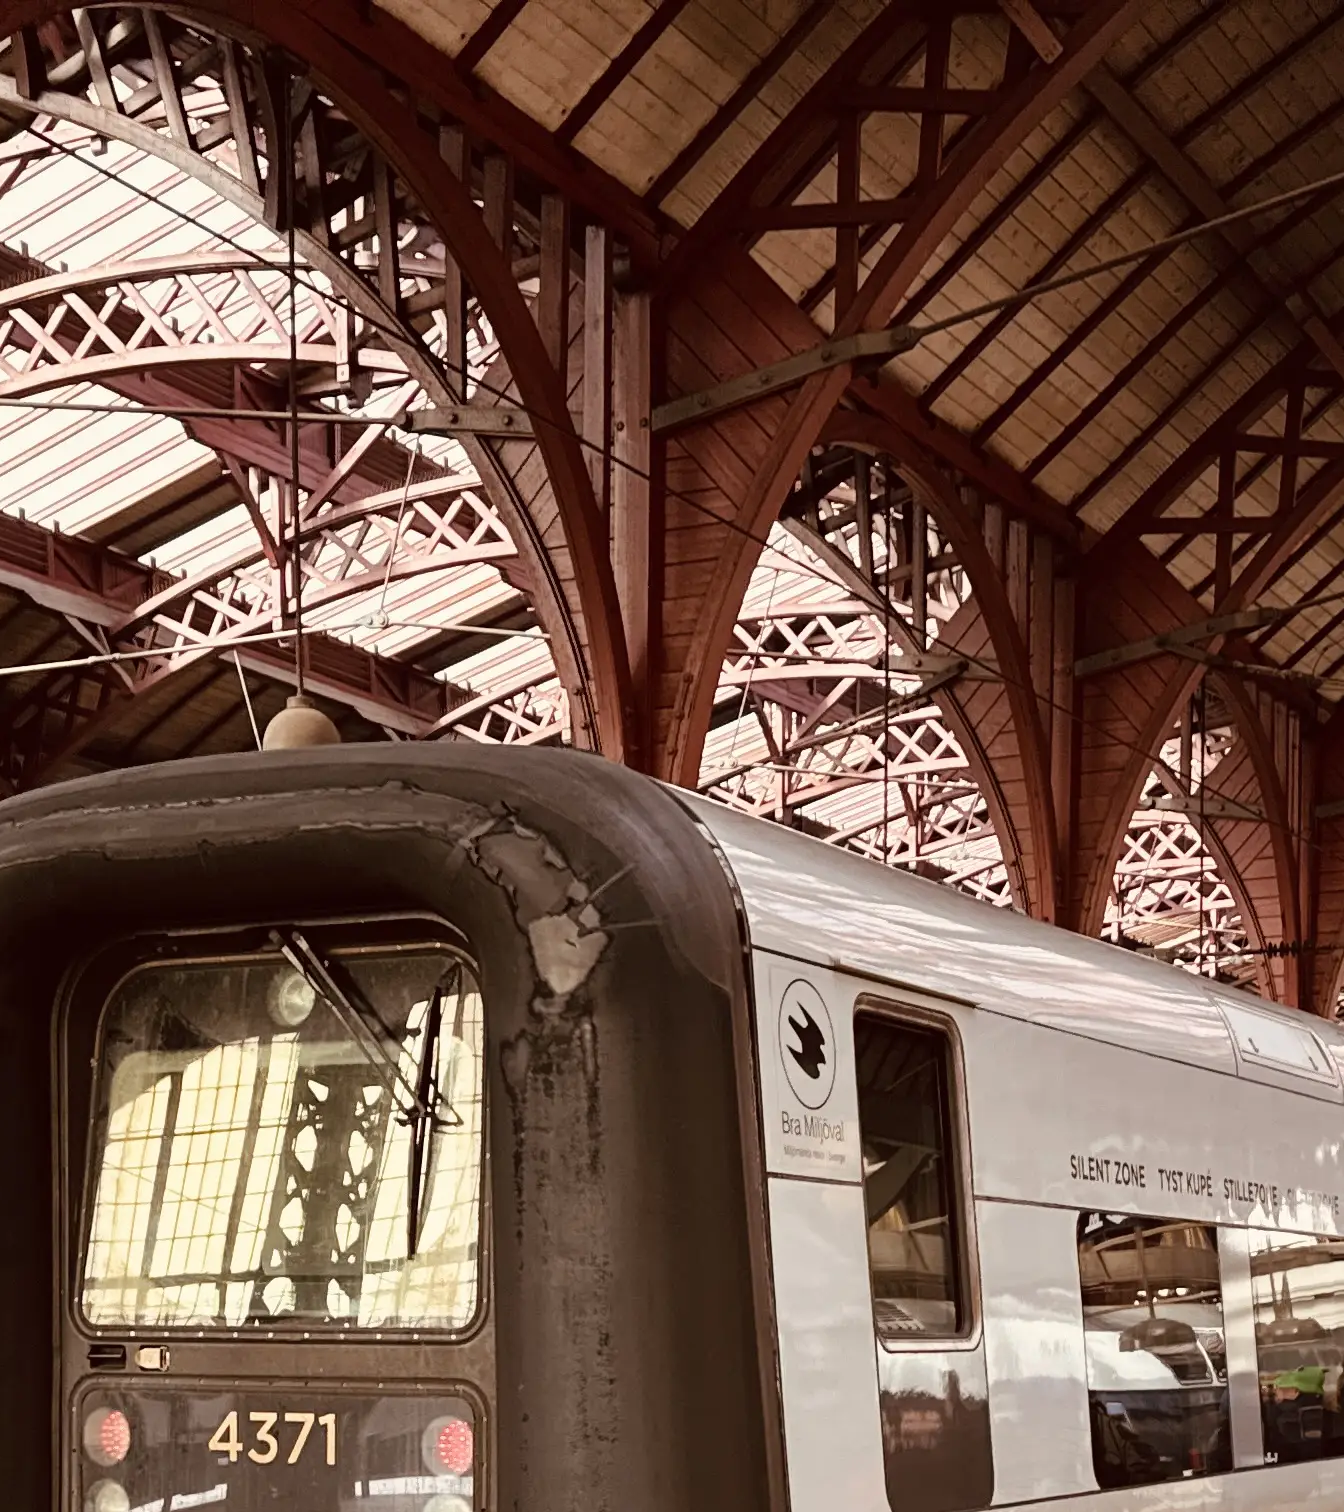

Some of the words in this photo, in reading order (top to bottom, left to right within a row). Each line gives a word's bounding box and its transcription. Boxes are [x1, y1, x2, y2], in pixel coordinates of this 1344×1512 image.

[782, 1111, 801, 1135] Bra
[1070, 1154, 1110, 1183] SILENT
[1114, 1161, 1146, 1188] ZONE
[1158, 1168, 1183, 1194] TYST
[1186, 1169, 1213, 1197] KUPÉ
[208, 1411, 337, 1466] 4371
